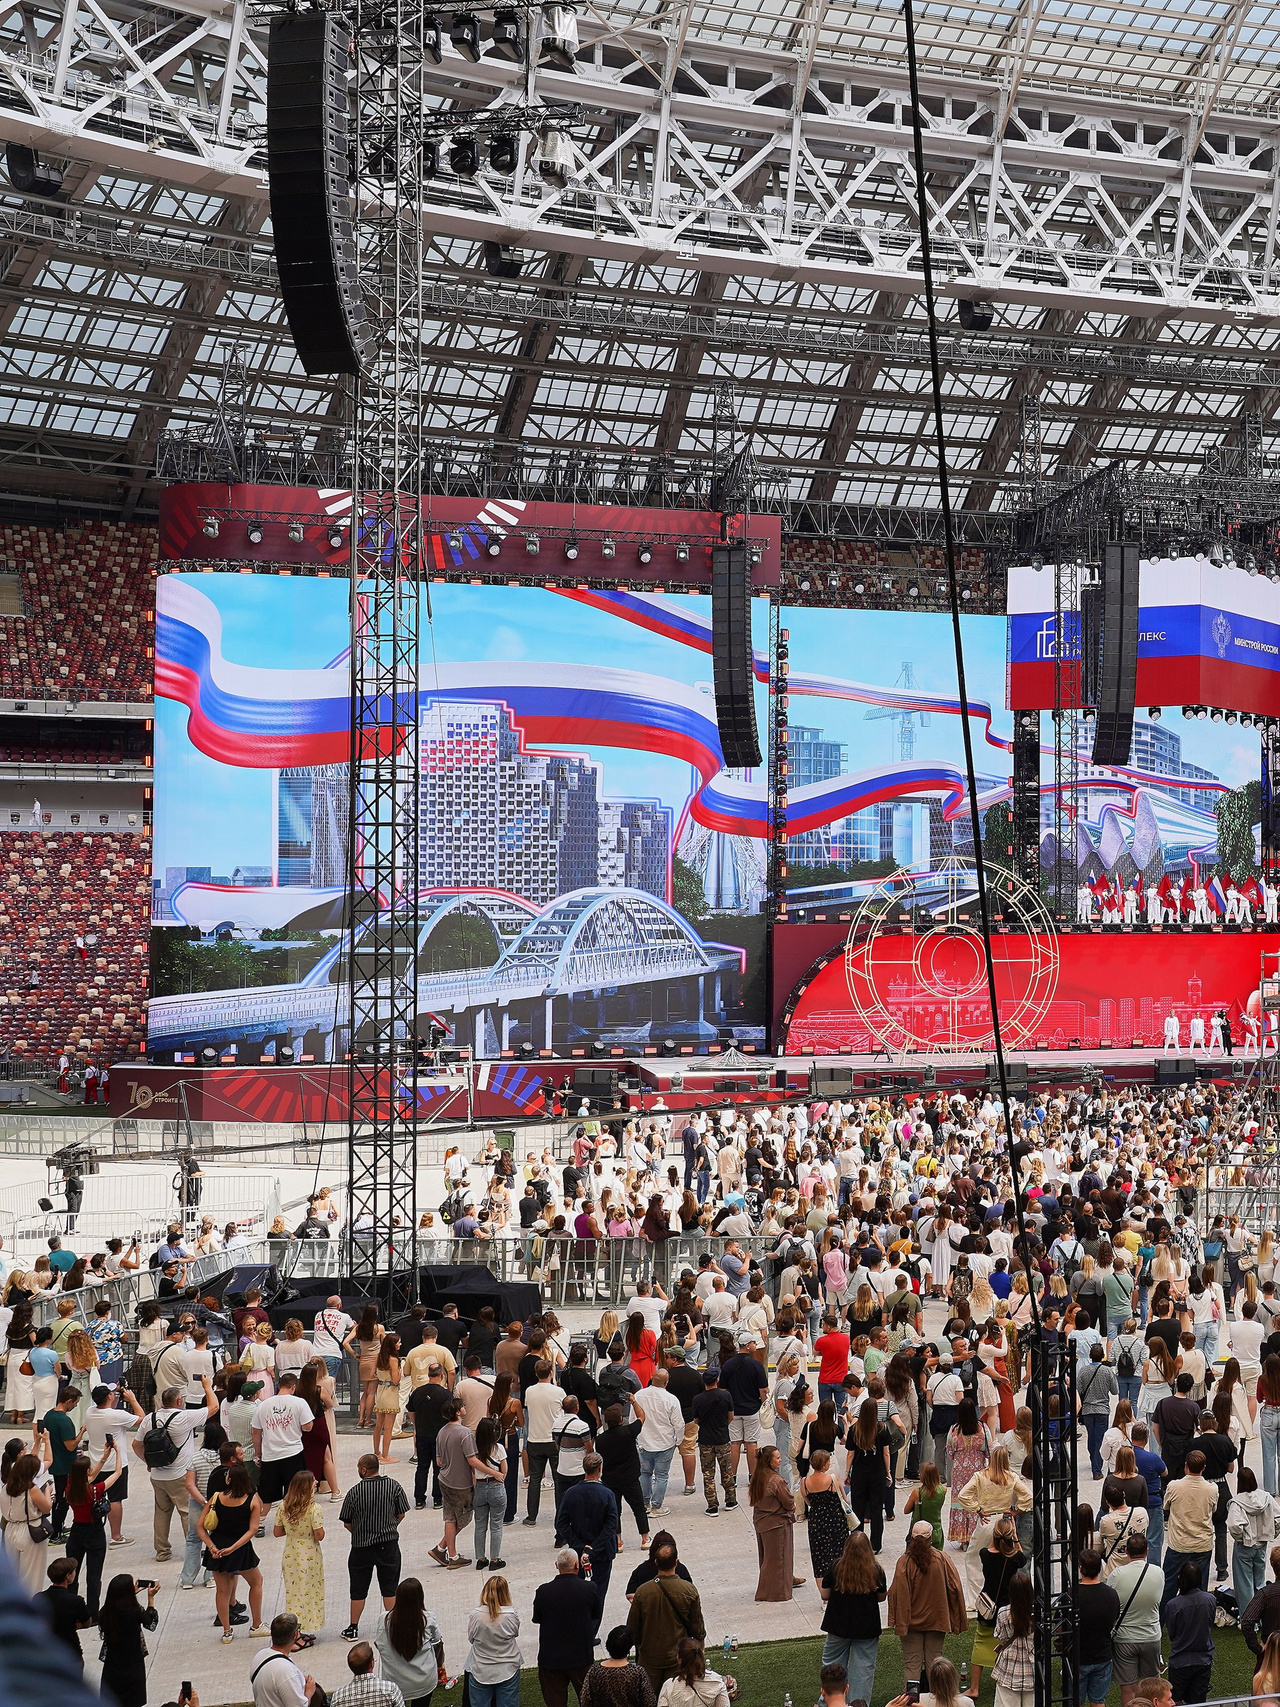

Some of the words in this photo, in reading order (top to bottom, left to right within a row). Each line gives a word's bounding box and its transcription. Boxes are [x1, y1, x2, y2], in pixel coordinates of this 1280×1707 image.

[1138, 631, 1167, 642] ЛЕКС
[1234, 636, 1261, 651] МИНСТРОЙ
[1261, 643, 1279, 655] РОССИИ
